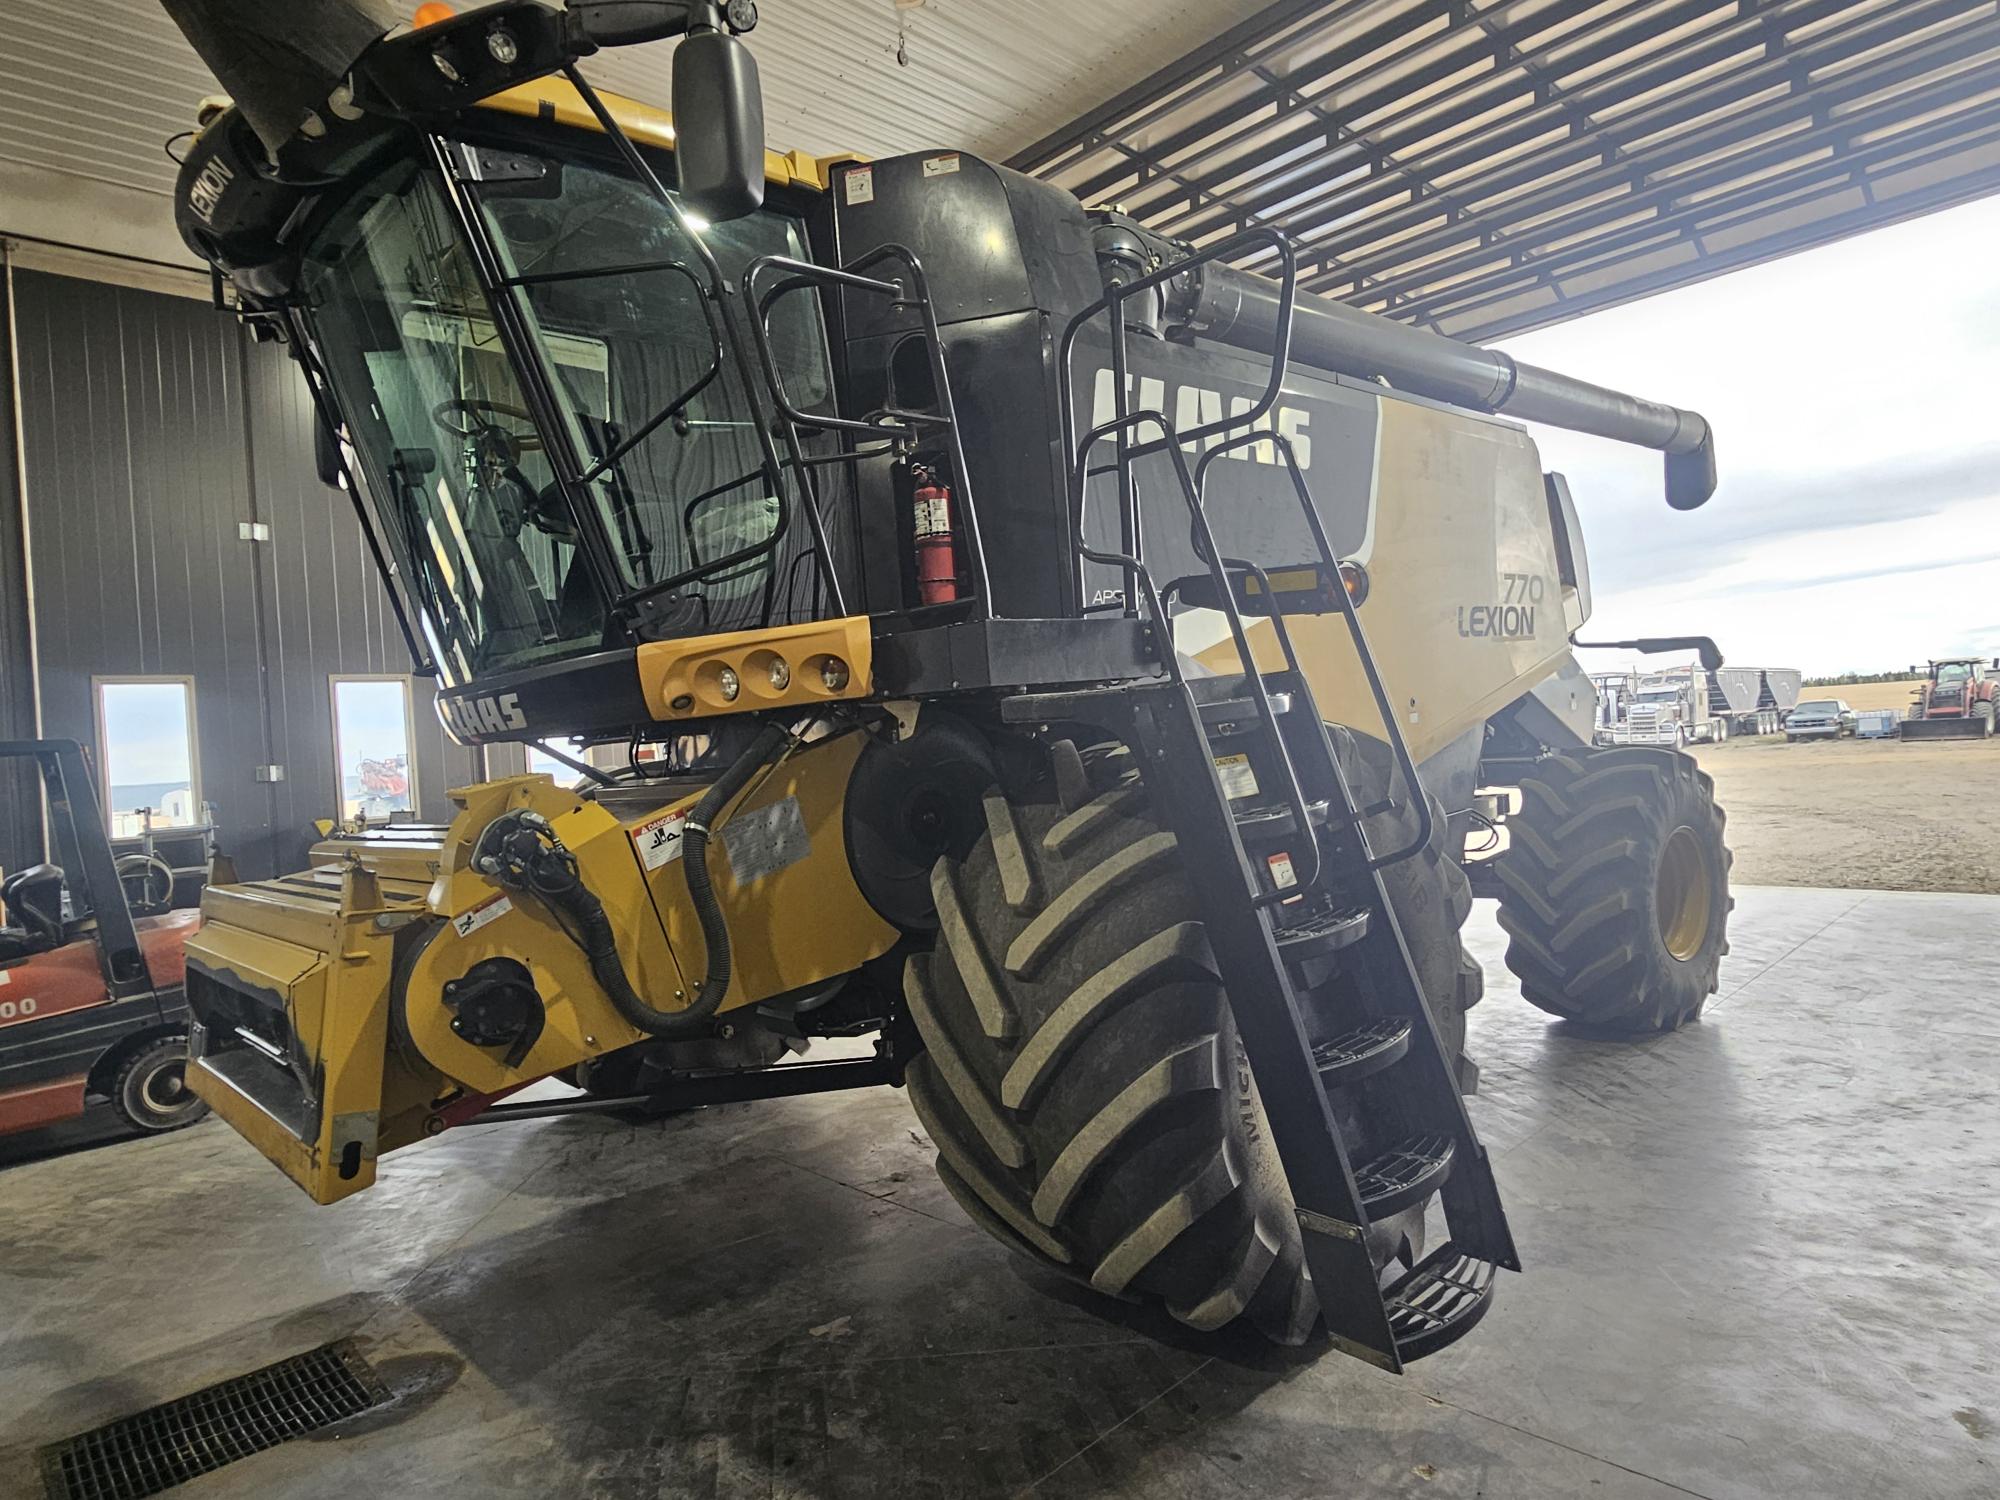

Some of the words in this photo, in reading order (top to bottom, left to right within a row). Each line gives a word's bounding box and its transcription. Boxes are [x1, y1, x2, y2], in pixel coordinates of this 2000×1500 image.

[188, 154, 234, 225] LEXION
[1091, 368, 1311, 470] CLAAS
[1503, 573, 1544, 605] 770
[1457, 606, 1534, 637] LEXION
[647, 813, 677, 831] DANGER
